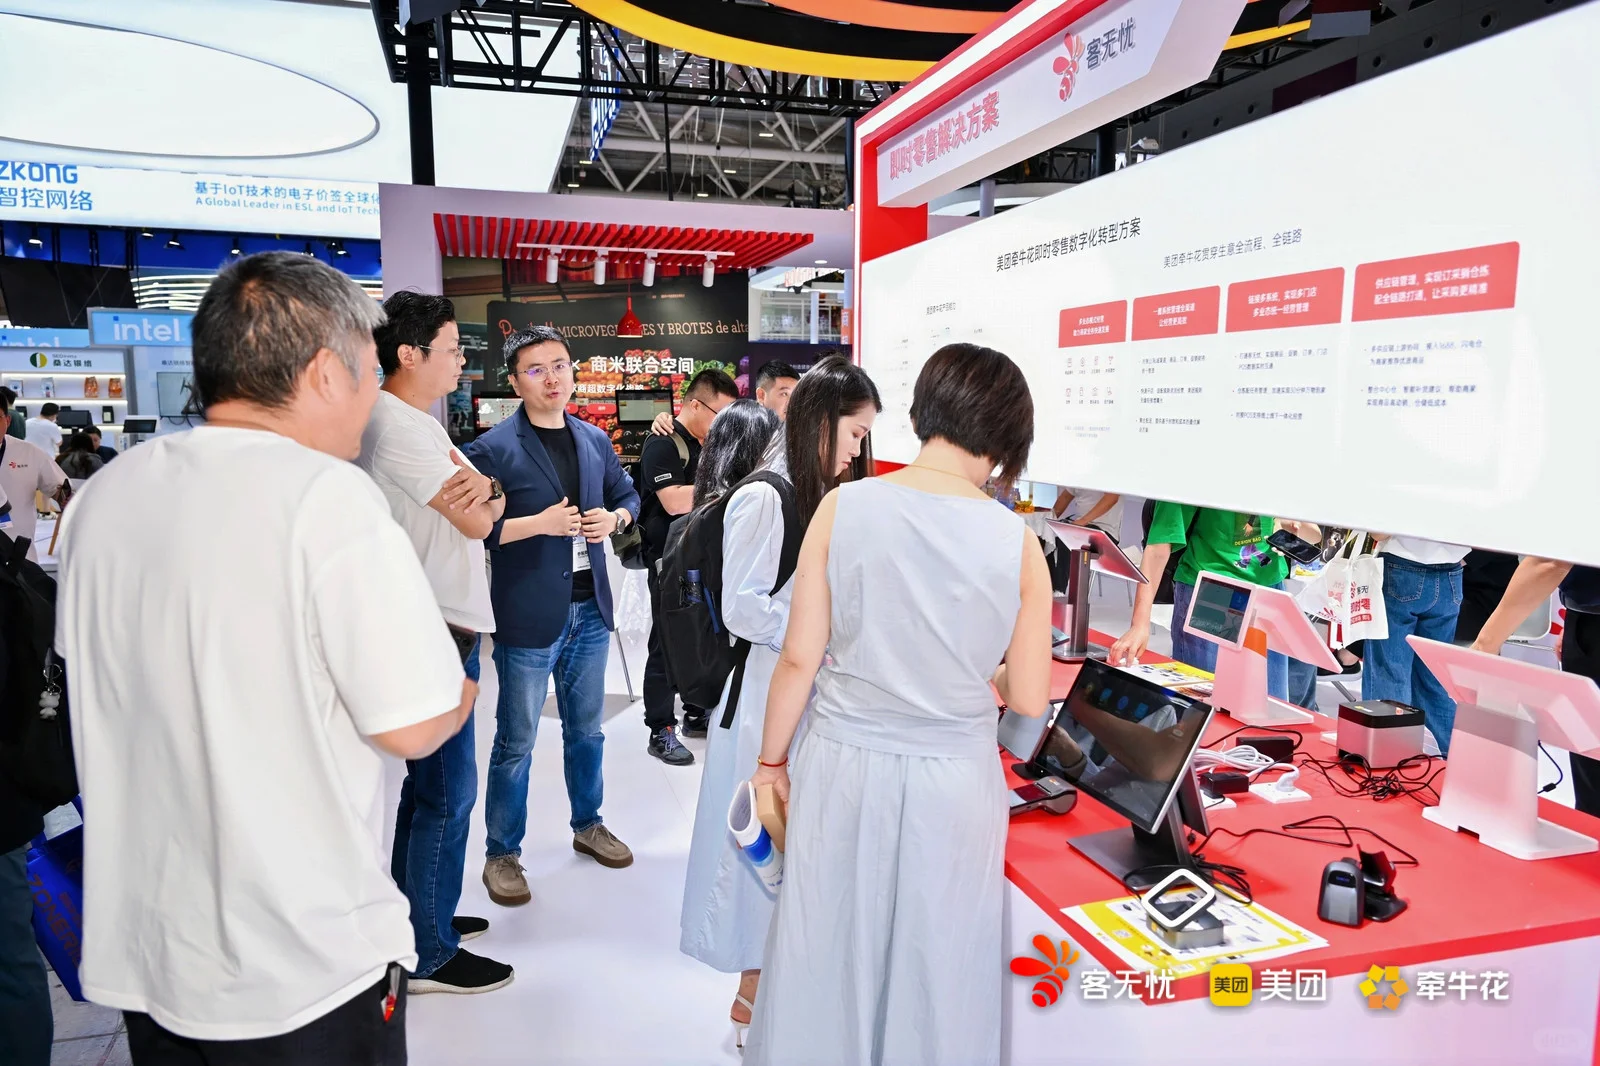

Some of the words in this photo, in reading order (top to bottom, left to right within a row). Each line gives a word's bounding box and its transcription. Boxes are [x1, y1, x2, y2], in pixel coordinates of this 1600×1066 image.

[1086, 17, 1137, 70] 客无忧
[889, 90, 1000, 180] 即时零售解决方案
[0, 187, 93, 211] 智控网络
[205, 198, 241, 208] Global
[243, 201, 279, 210] Leader
[295, 203, 313, 212] ESL
[317, 204, 335, 213] and
[996, 216, 1141, 273] 美团牵牛花即时零售数字化转型方案
[113, 315, 181, 342] intel
[657, 323, 665, 335] Y
[667, 321, 714, 335] BROTES
[716, 320, 729, 334] de
[590, 355, 695, 375] 商米联合空间
